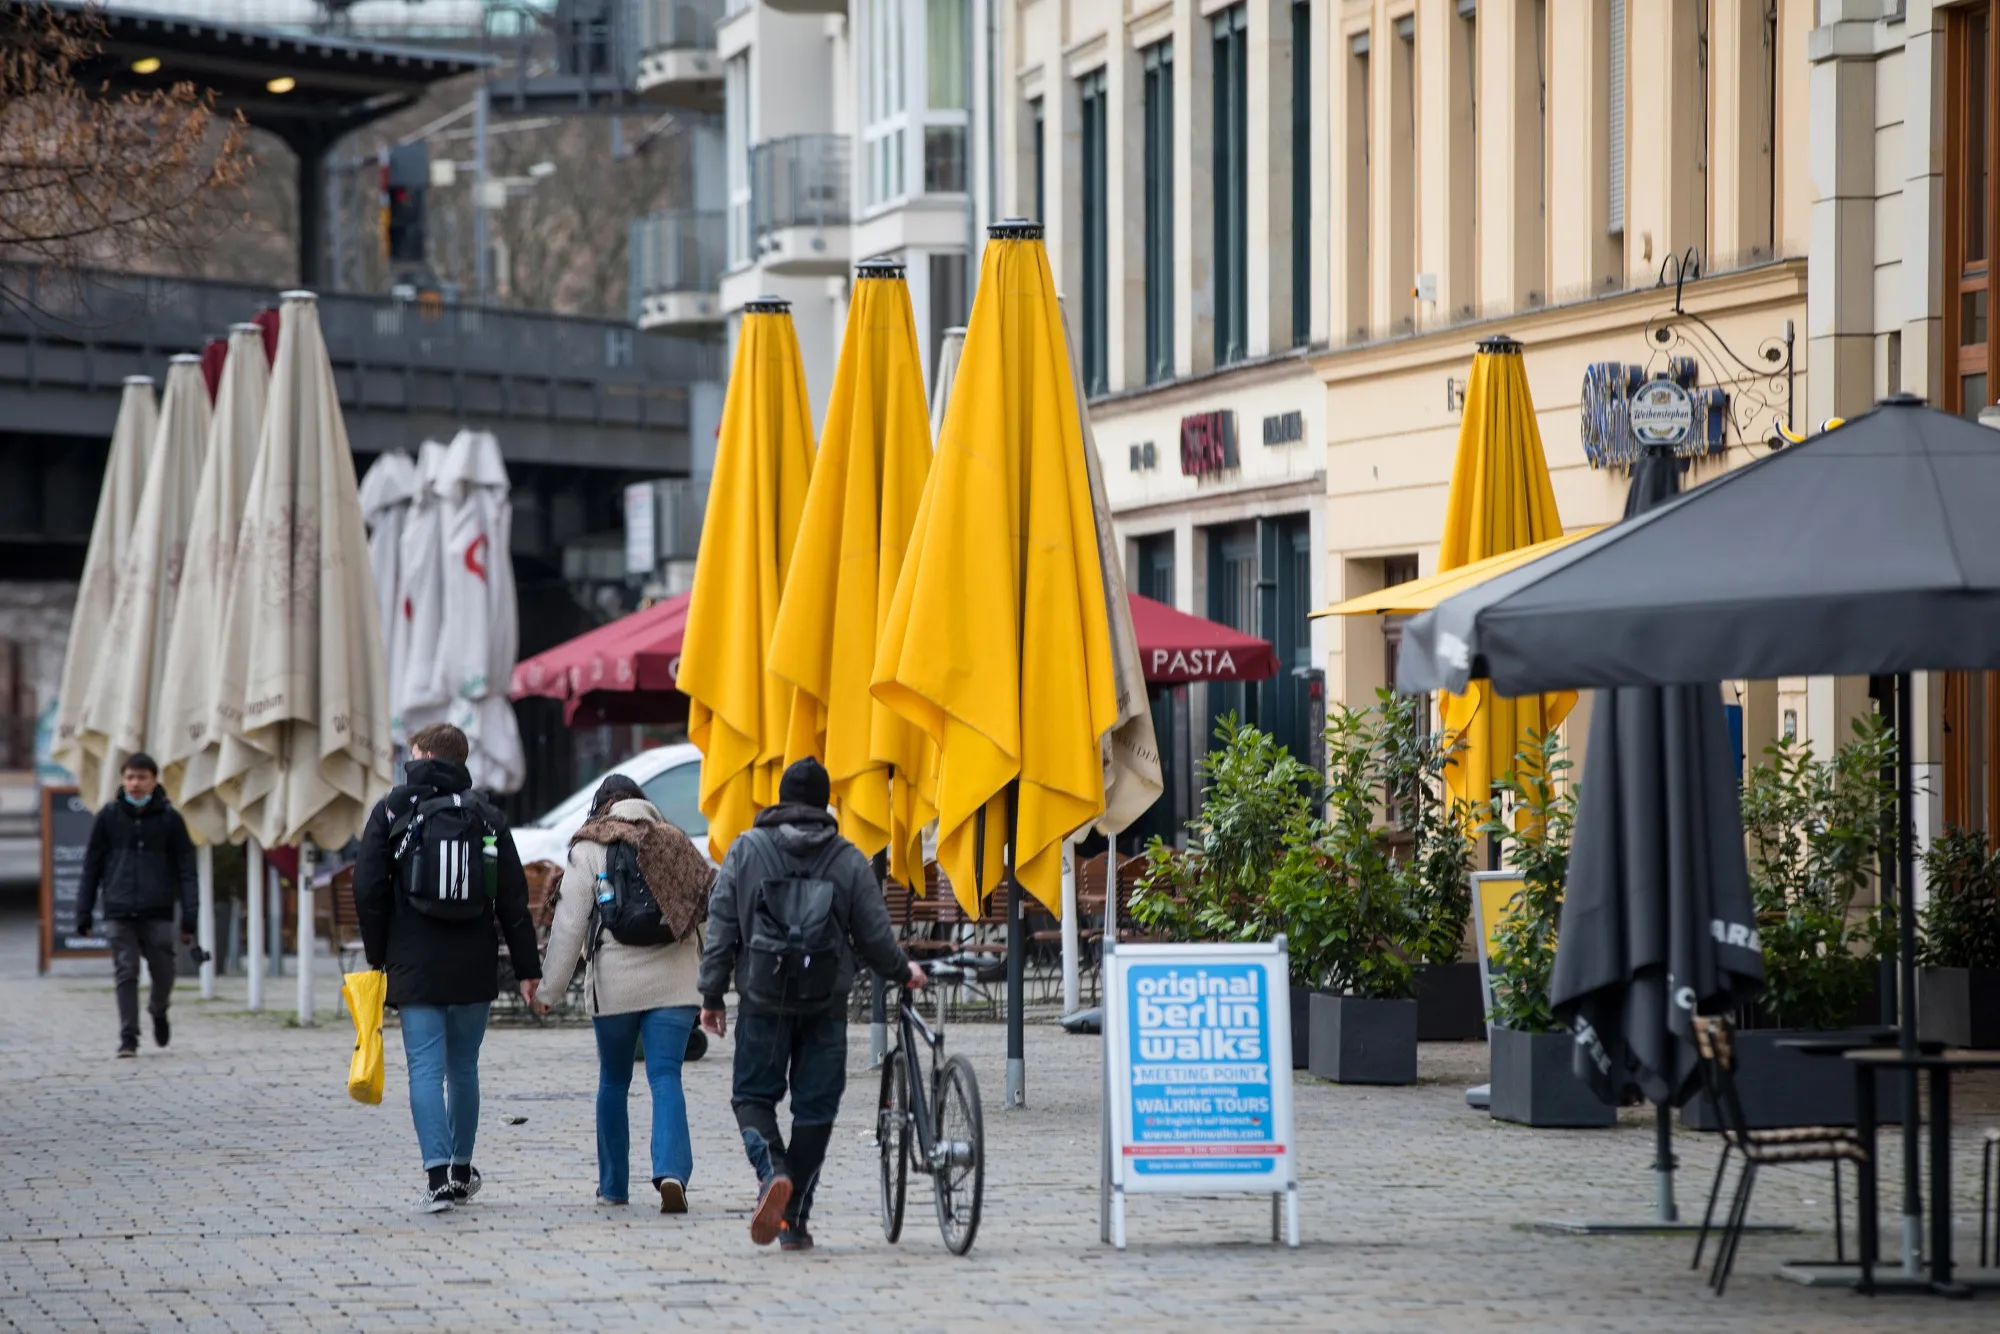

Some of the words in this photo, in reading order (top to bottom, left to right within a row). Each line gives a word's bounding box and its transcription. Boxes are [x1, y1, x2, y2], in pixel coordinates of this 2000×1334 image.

[1634, 407, 1689, 421] Weihenstephan
[1152, 648, 1237, 675] PASTA
[1136, 970, 1258, 1003] original
[1137, 996, 1259, 1028] berlin
[1139, 1029, 1261, 1060] walks
[1141, 1067, 1209, 1081] MEETING
[1213, 1067, 1259, 1080] POINT
[1165, 1086, 1238, 1097] Award-winning
[1136, 1098, 1212, 1114] WALKING
[1215, 1097, 1269, 1113] TOURS
[1142, 1127, 1264, 1140] www.berlinwalks.com
